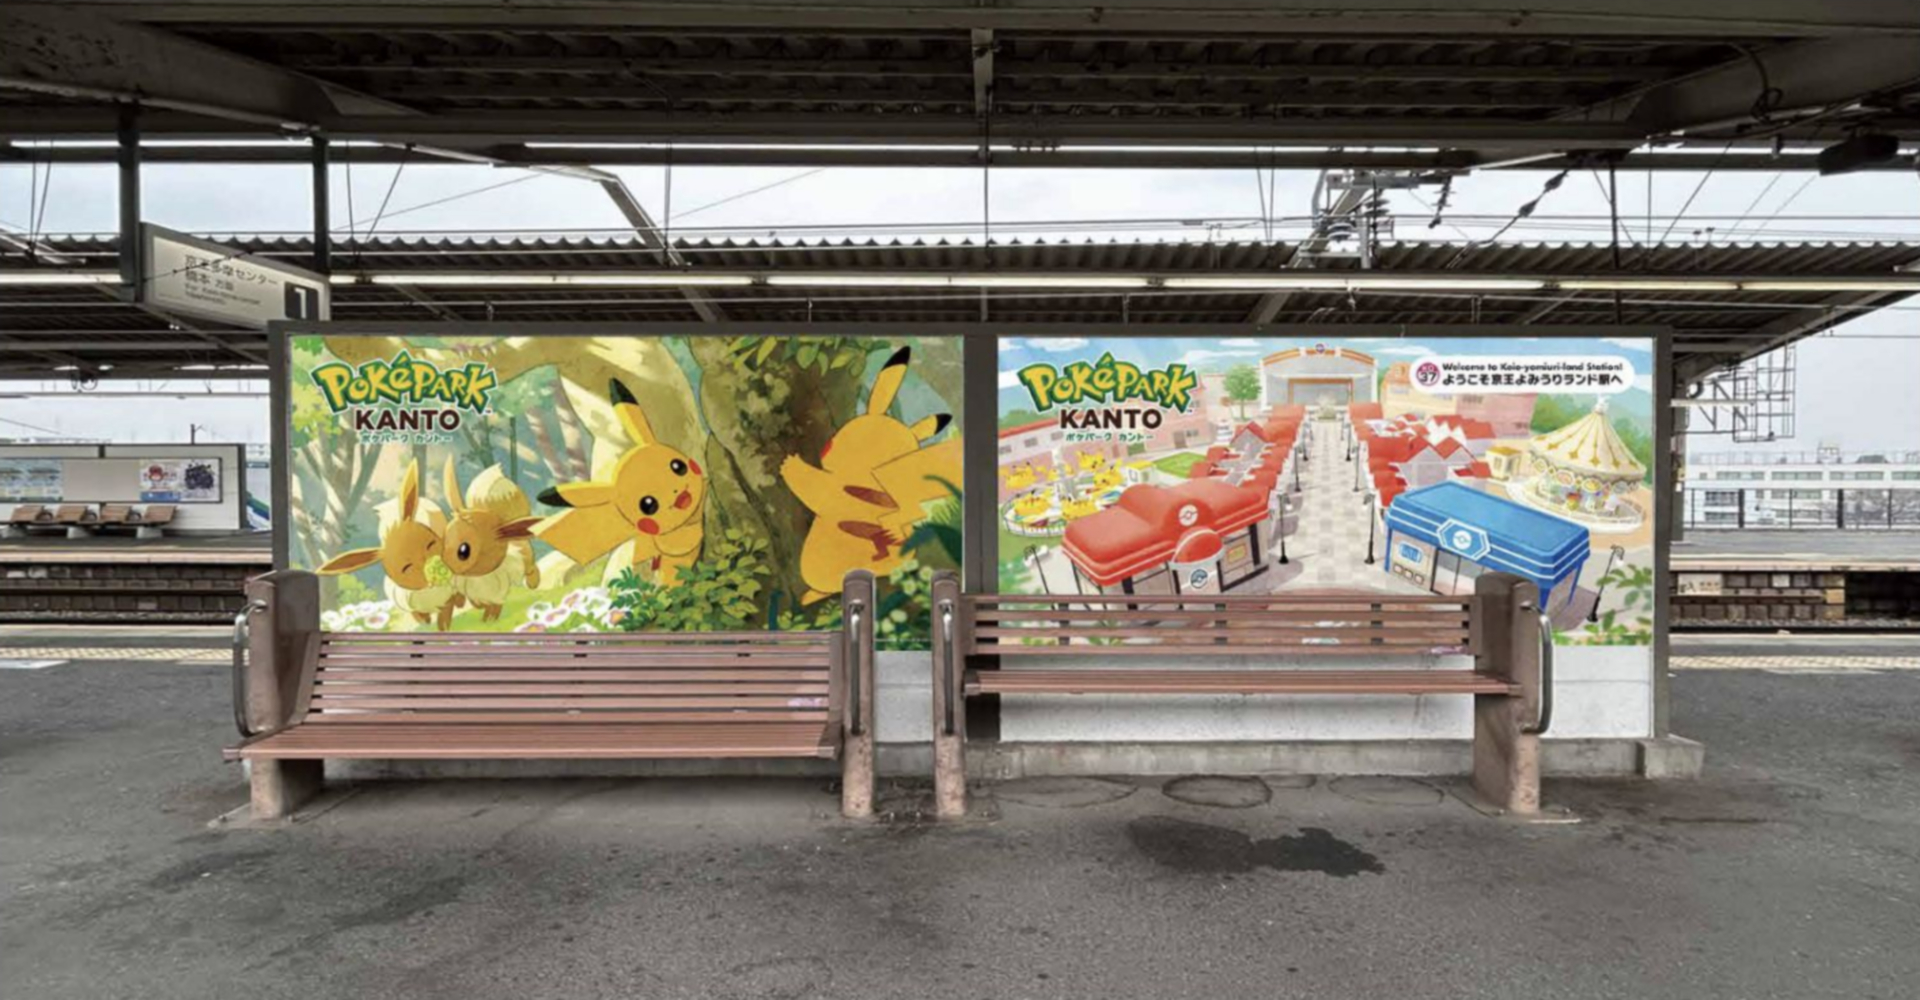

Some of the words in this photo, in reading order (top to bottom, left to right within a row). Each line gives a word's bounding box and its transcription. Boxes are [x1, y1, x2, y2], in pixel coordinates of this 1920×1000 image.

[294, 286, 307, 319] 1
[1442, 362, 1485, 371] Welcome
[1488, 363, 1498, 371] to
[1586, 362, 1623, 371] Station!
[1420, 372, 1437, 383] 37
[1442, 374, 1623, 386] ようこそ京王よみうりランド駅へ
[355, 409, 460, 431] KANTO
[1060, 409, 1163, 429] KANTO
[361, 433, 409, 444] ポケパーク
[416, 433, 452, 443] カントー
[1065, 432, 1112, 442] ポケパーク
[1119, 432, 1154, 442] カントー
